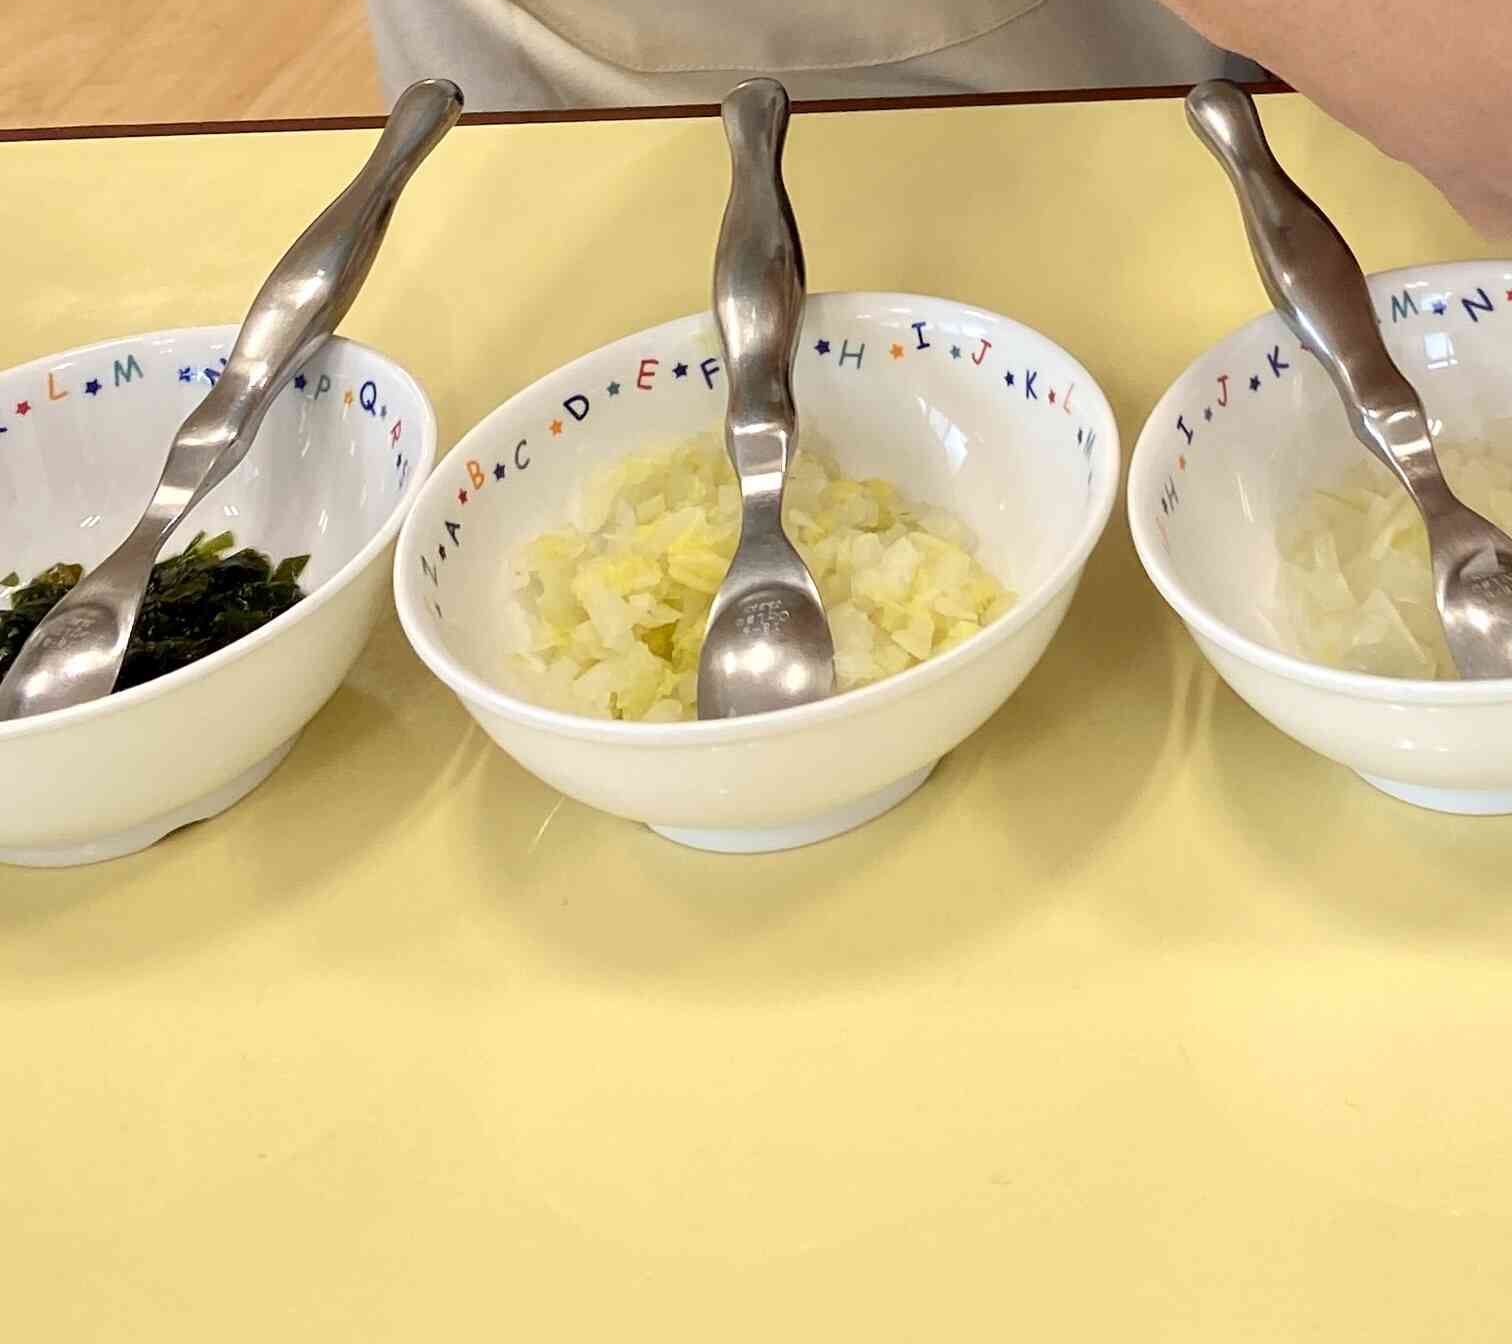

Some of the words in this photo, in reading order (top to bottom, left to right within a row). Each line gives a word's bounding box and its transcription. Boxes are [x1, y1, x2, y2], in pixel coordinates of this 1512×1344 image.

[1391, 290, 1419, 324] M
[1461, 287, 1494, 323] N
[48, 373, 68, 401] L
[113, 354, 144, 387] M
[314, 375, 332, 401] P
[360, 381, 376, 416] Q
[1176, 415, 1194, 445] I
[1217, 375, 1229, 407] J
[1267, 345, 1290, 378] K
[445, 520, 461, 547] A
[466, 461, 485, 490] B
[514, 439, 531, 470] C
[563, 394, 590, 421] D
[636, 358, 659, 390] E
[700, 358, 721, 390] F
[838, 339, 865, 369] H
[911, 321, 930, 350] I
[971, 338, 992, 365] J
[1025, 370, 1037, 400] K
